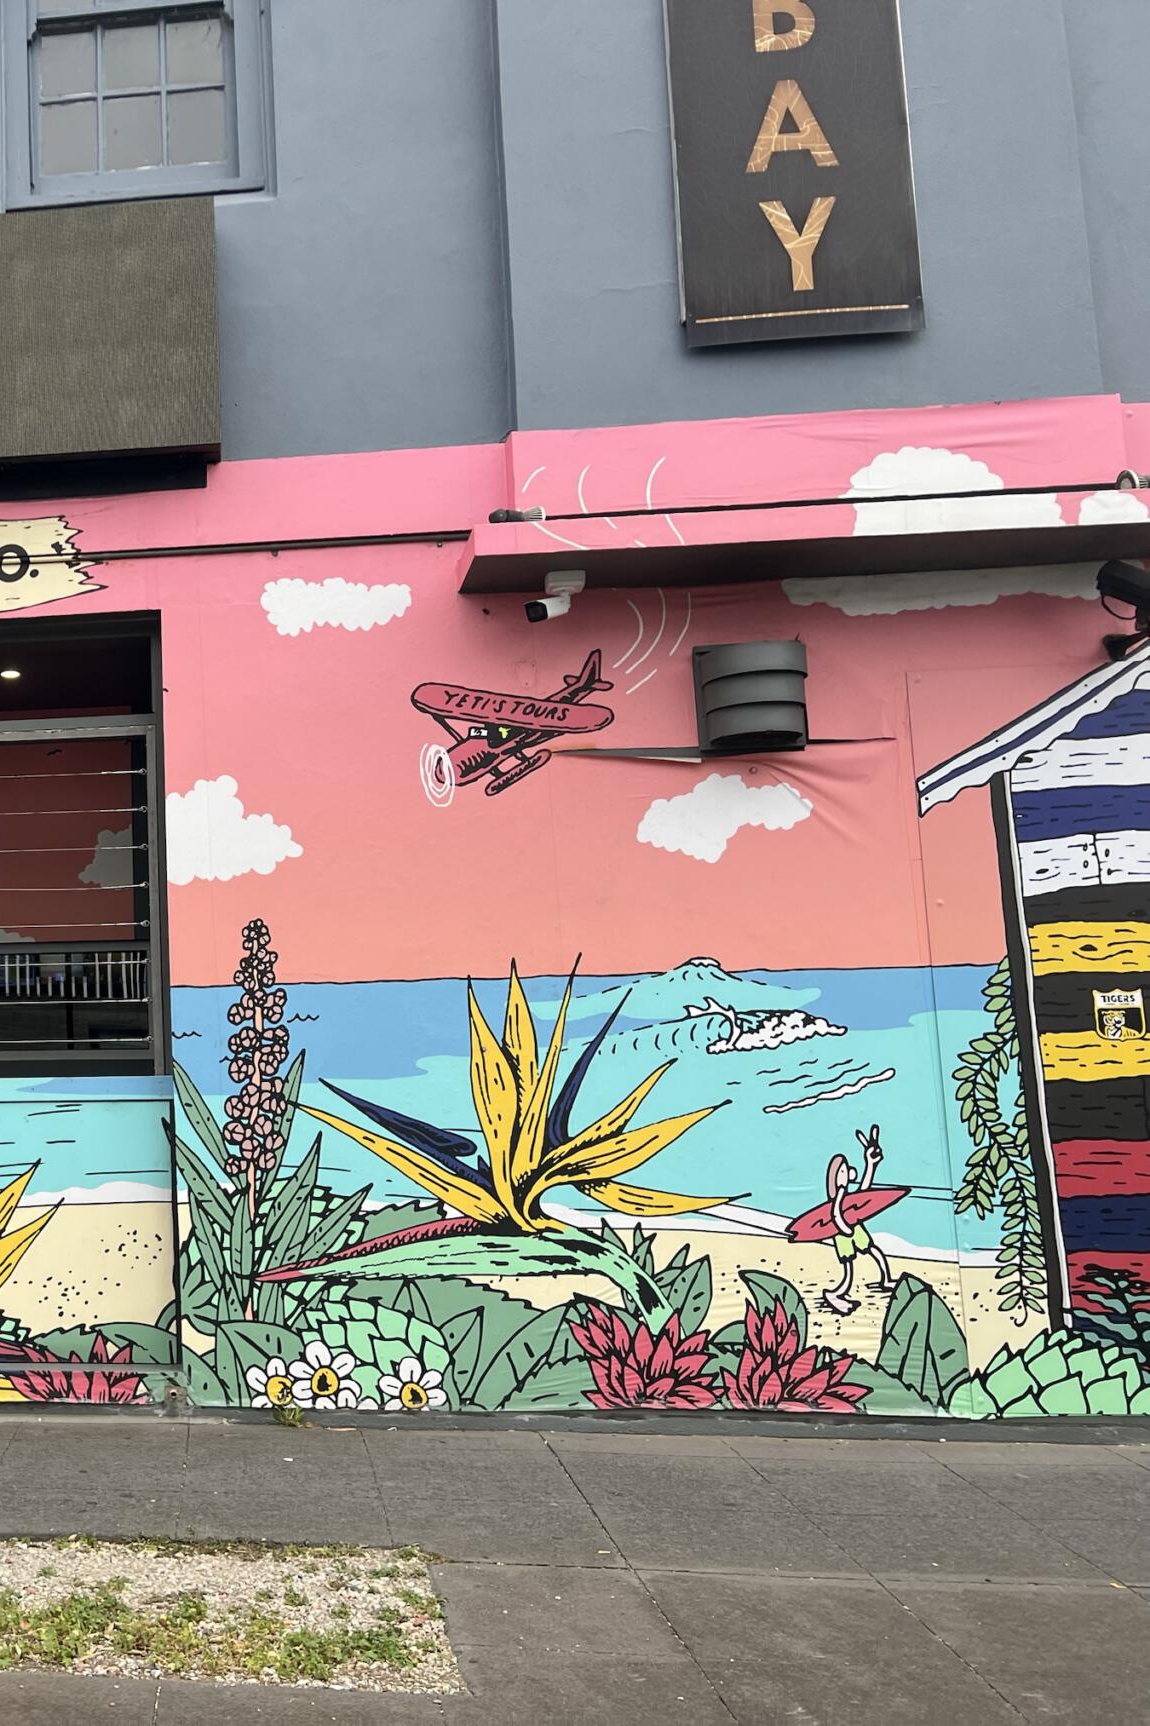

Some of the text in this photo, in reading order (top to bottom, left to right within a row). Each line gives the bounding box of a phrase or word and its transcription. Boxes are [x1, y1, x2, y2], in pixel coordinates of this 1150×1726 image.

[745, 0, 840, 292] BAY
[443, 690, 571, 722] YETI'S TOURS
